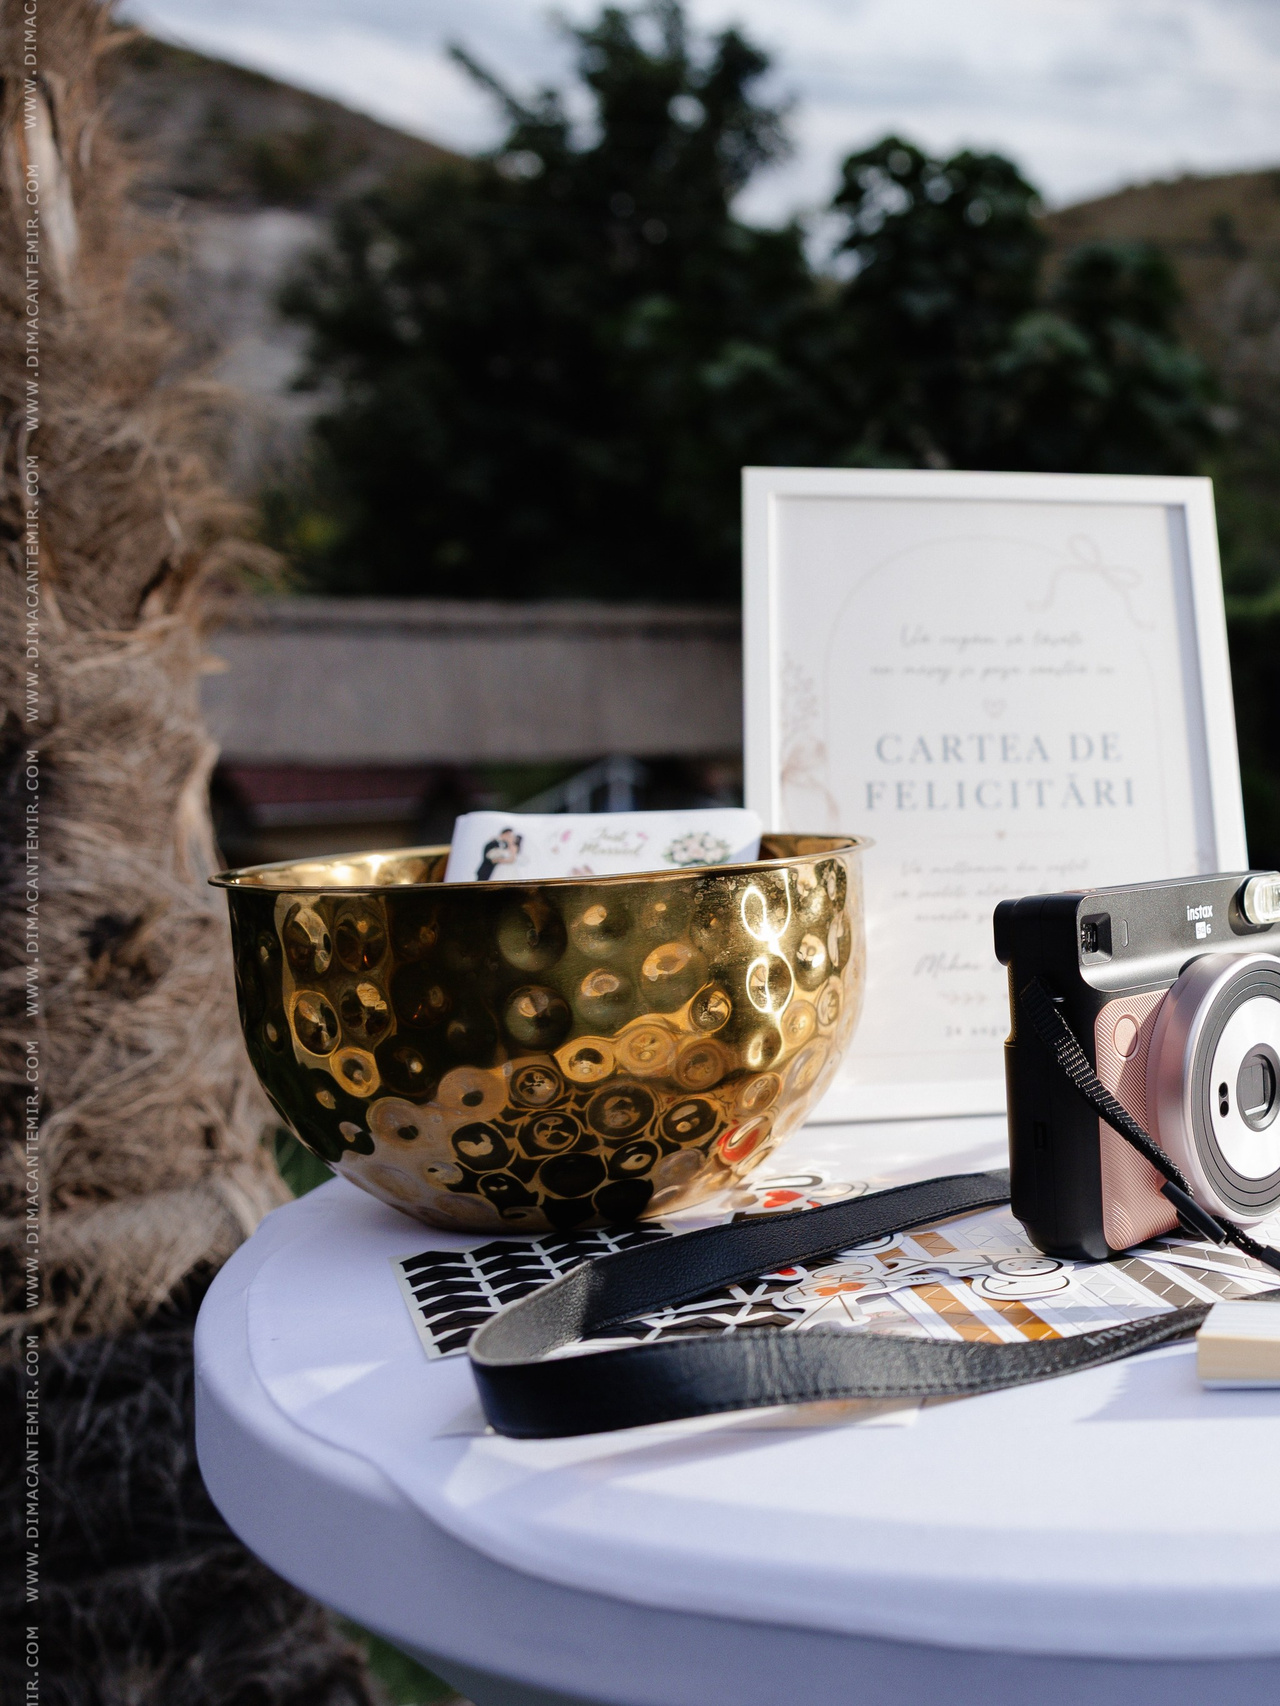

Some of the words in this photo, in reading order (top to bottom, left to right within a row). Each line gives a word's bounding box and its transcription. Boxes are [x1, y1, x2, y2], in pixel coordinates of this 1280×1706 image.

[875, 731, 1050, 765] CARTEA
[1069, 730, 1123, 764] DE
[864, 771, 1135, 812] FELICITĂRI
[1186, 904, 1213, 921] instax
